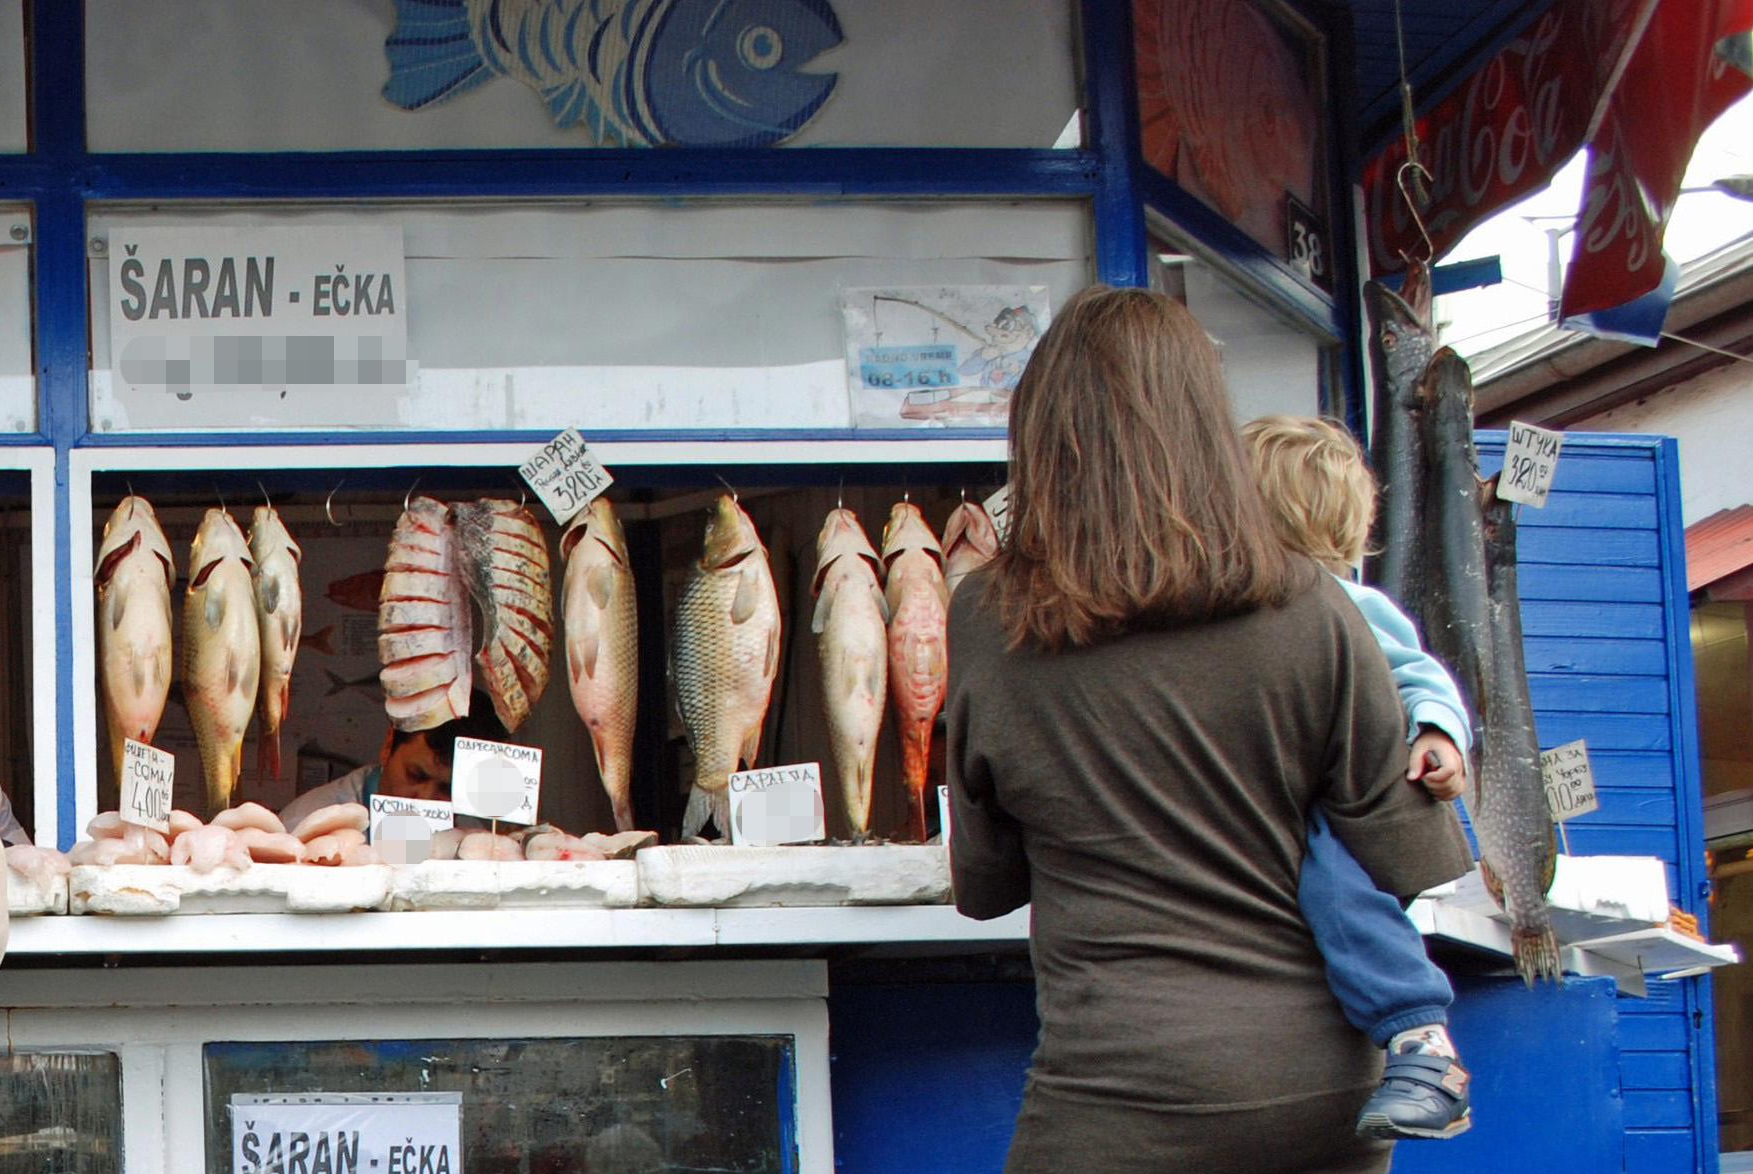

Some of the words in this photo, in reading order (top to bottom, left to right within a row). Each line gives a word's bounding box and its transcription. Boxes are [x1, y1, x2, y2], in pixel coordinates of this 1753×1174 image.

[1293, 221, 1324, 276] 38
[120, 244, 275, 321] ŠARAN
[289, 291, 300, 303] -
[313, 264, 395, 316] EČKA
[520, 432, 578, 481] ШАРАН
[1511, 426, 1558, 462] ШТУКА
[552, 470, 598, 512] 320
[1508, 454, 1538, 493] 320
[131, 781, 162, 822] 400
